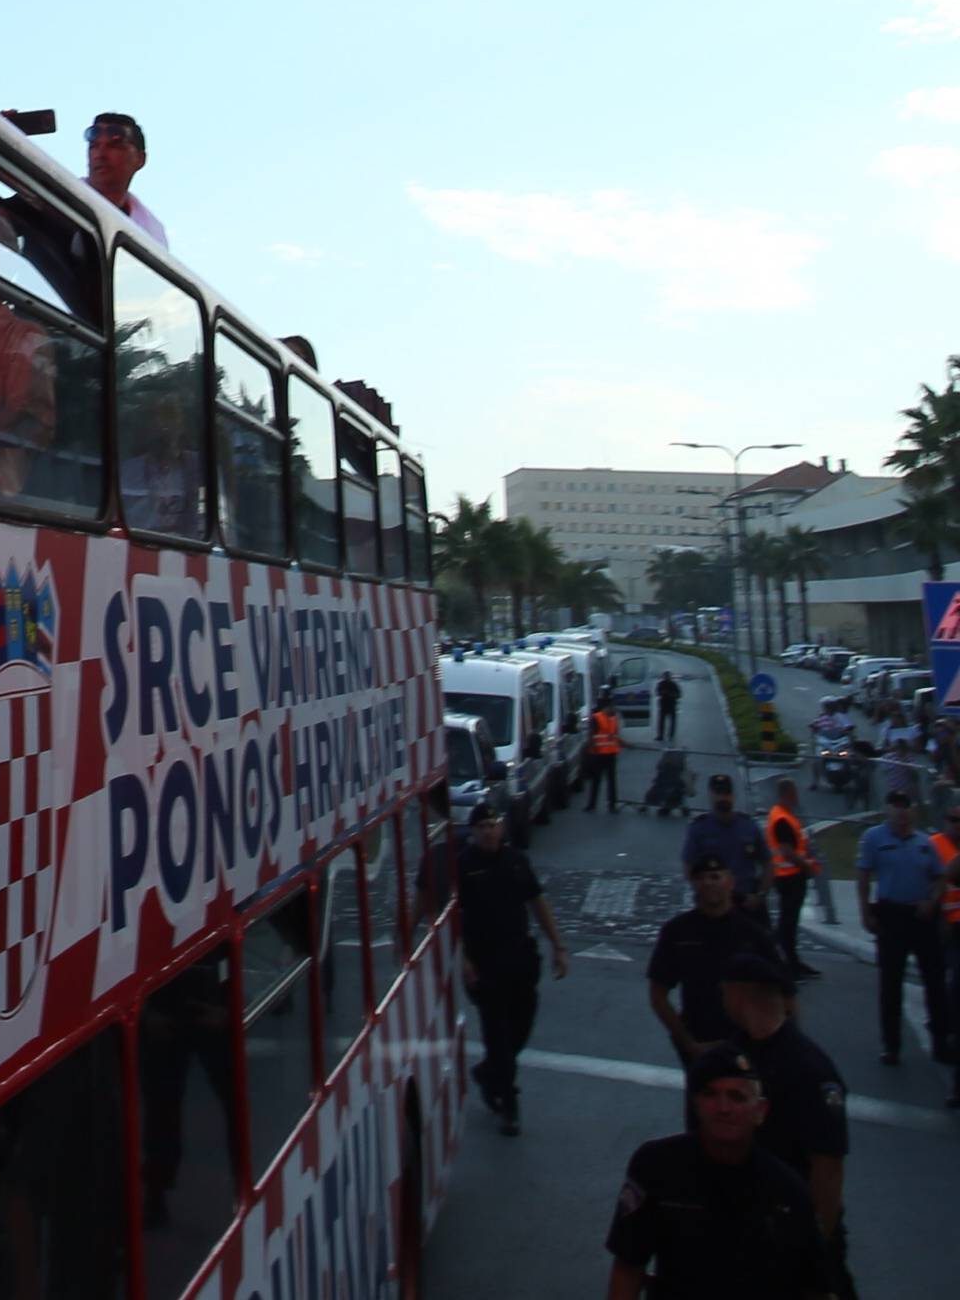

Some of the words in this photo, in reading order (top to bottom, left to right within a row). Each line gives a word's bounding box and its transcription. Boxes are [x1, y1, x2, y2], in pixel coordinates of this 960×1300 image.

[103, 590, 239, 746] SRCE
[247, 603, 374, 710] VATRENO
[108, 733, 281, 933] PONOS
